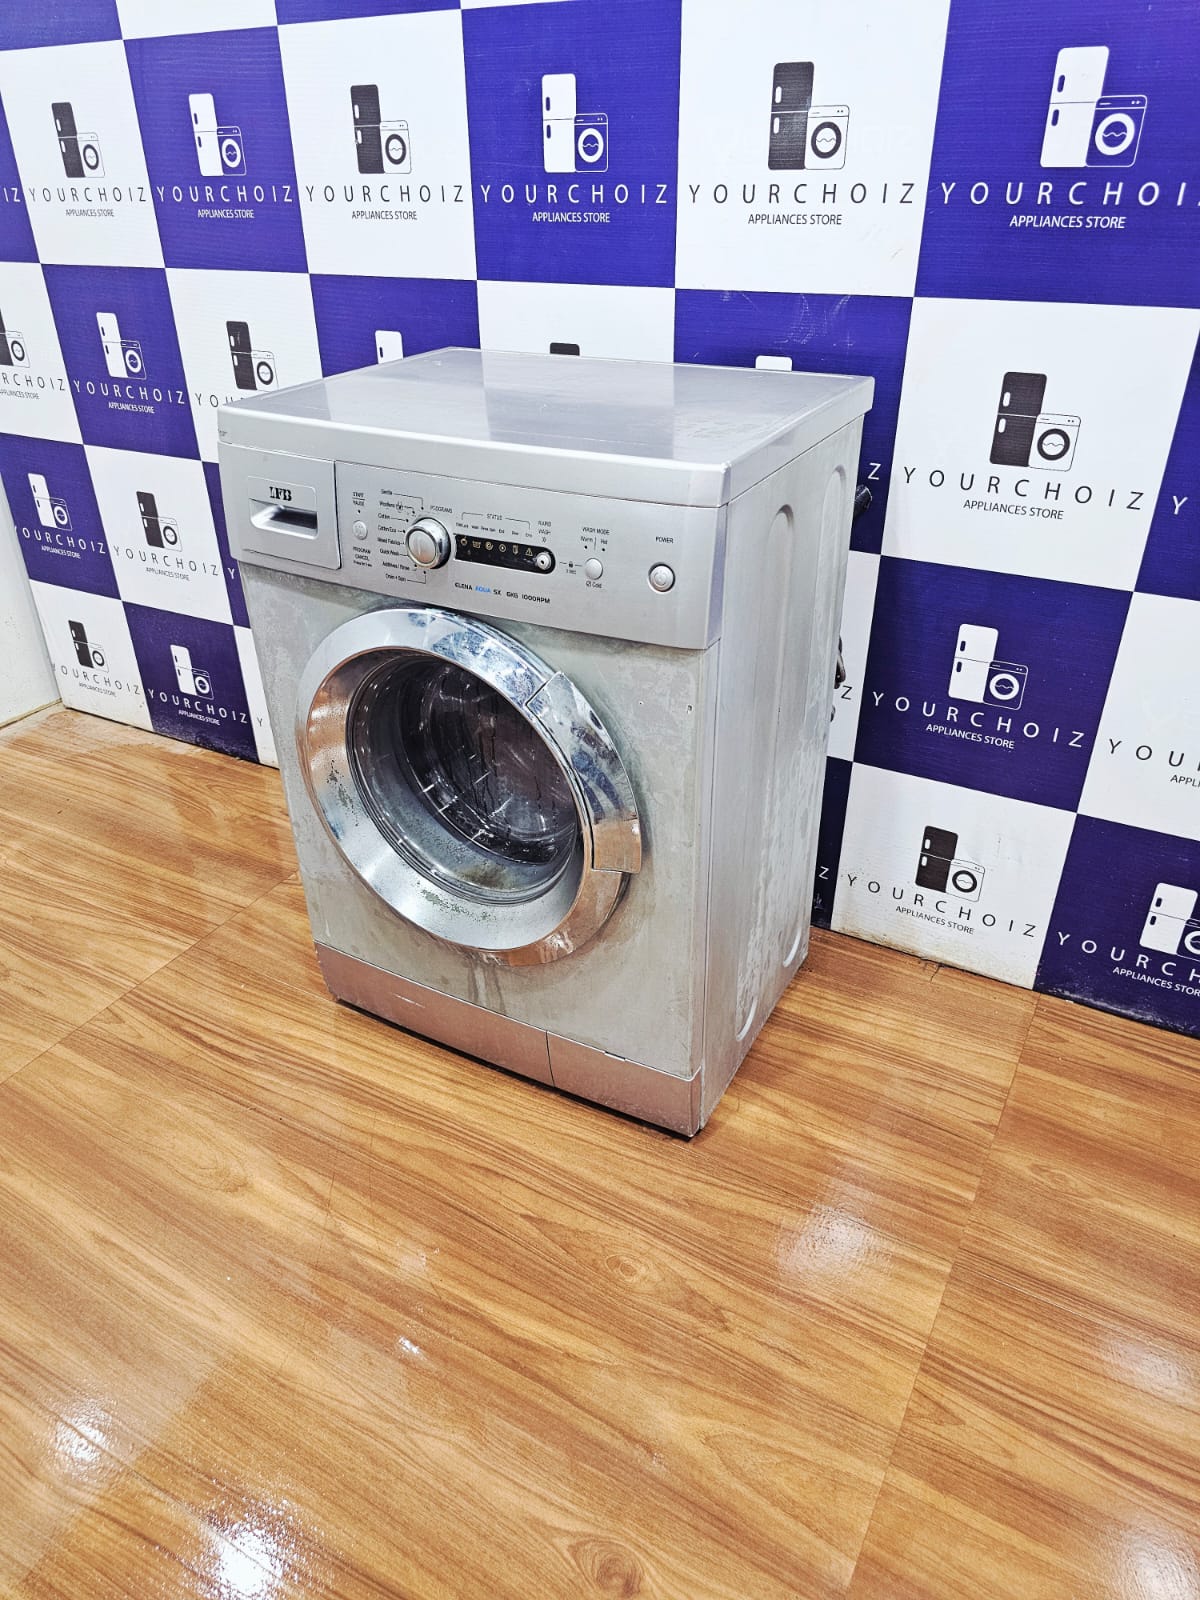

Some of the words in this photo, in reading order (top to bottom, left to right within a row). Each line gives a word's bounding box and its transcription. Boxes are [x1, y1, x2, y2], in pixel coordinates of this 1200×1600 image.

[29, 187, 147, 202] YOURCHOIZ
[156, 185, 293, 203] YOURCHOIZ
[305, 185, 464, 203] YOURCHOIZ
[480, 184, 668, 204] YOURCHOIZ
[689, 183, 915, 204] YOURCHOIZ
[941, 181, 1200, 206] YOURCHOI
[65, 208, 96, 218] APPLIANCES
[97, 208, 115, 218] STORE
[197, 209, 233, 219] APPLIANCES
[234, 209, 255, 219] STORE
[351, 210, 393, 220] APPLIANCES
[395, 210, 418, 221] STORE
[532, 211, 581, 222] APPLIANCES
[583, 212, 610, 223] STORE
[748, 213, 807, 225] APPLIANCES
[809, 214, 842, 225] STORE
[1009, 215, 1083, 228] APPLIANCES
[1085, 216, 1127, 229] STORE
[73, 379, 185, 405] YOURCHOIZ
[108, 401, 138, 412] APPLIANCES
[138, 404, 155, 414] STORE
[269, 486, 292, 501] IFB
[903, 466, 1144, 510] YOURCHOIZ
[963, 499, 1027, 516] APPLIANCES
[1029, 507, 1064, 520] STORE
[655, 536, 674, 544] POWER
[113, 545, 219, 577] YOURCHOIZ
[455, 582, 472, 590] ELENA
[475, 585, 491, 593] AQUA
[522, 593, 550, 604] 1000RPM
[148, 688, 247, 724] YOURCHOIZ
[872, 691, 1085, 748] YOURCHOIZ
[926, 723, 983, 743] APPLIANCES
[984, 734, 1015, 750] STORE
[847, 874, 1036, 938] YOURCHOIZ
[895, 905, 946, 927] APPLIANCES
[947, 919, 974, 935] STORE
[1112, 967, 1173, 989] APPLIANCES
